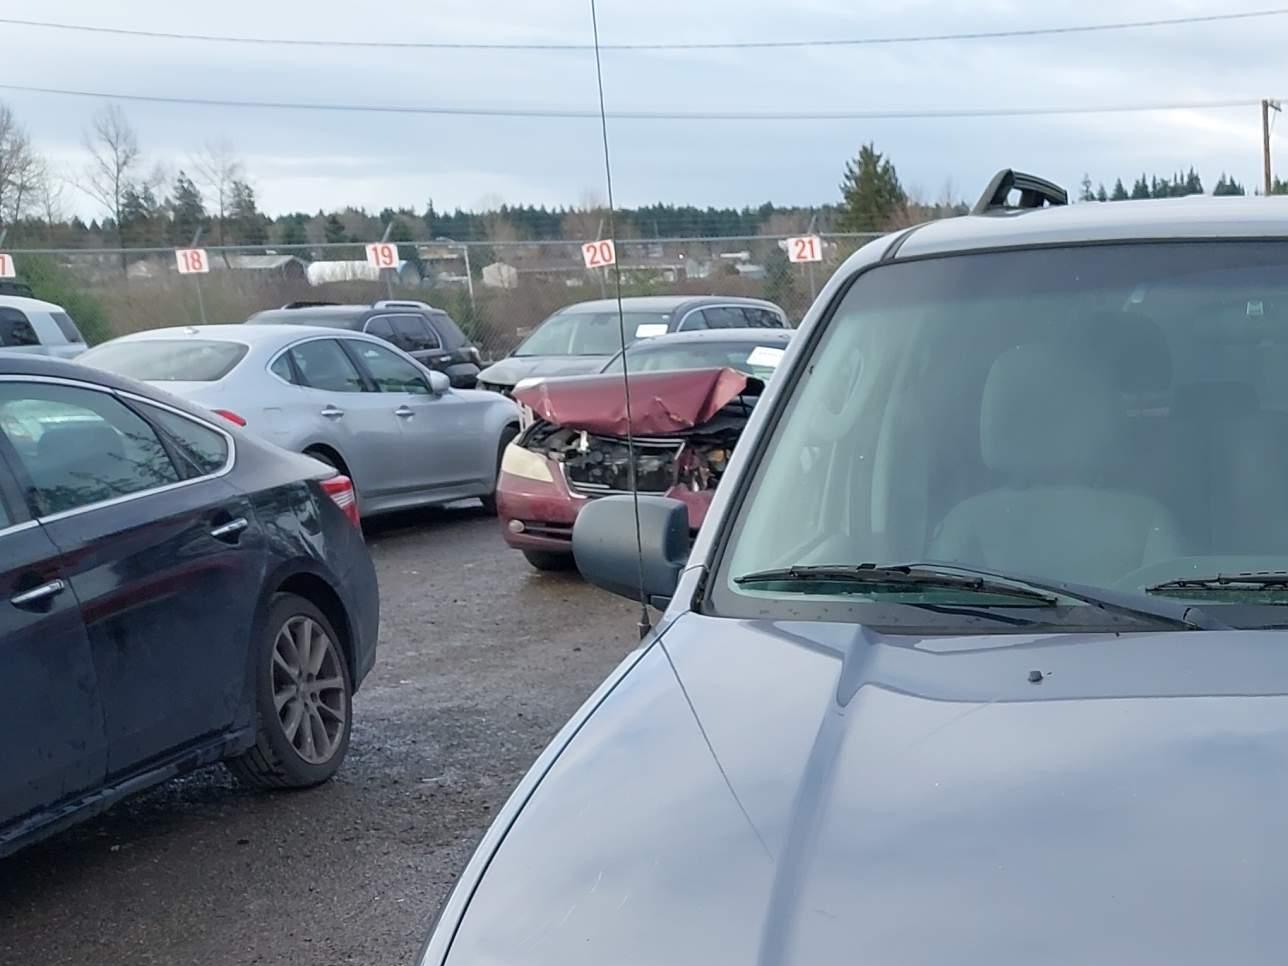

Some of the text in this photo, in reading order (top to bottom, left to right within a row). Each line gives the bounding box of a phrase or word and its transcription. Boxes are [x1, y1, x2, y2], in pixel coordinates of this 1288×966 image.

[372, 246, 395, 266] 19
[586, 242, 613, 266] 20
[795, 239, 816, 261] 21
[182, 251, 202, 271] 18
